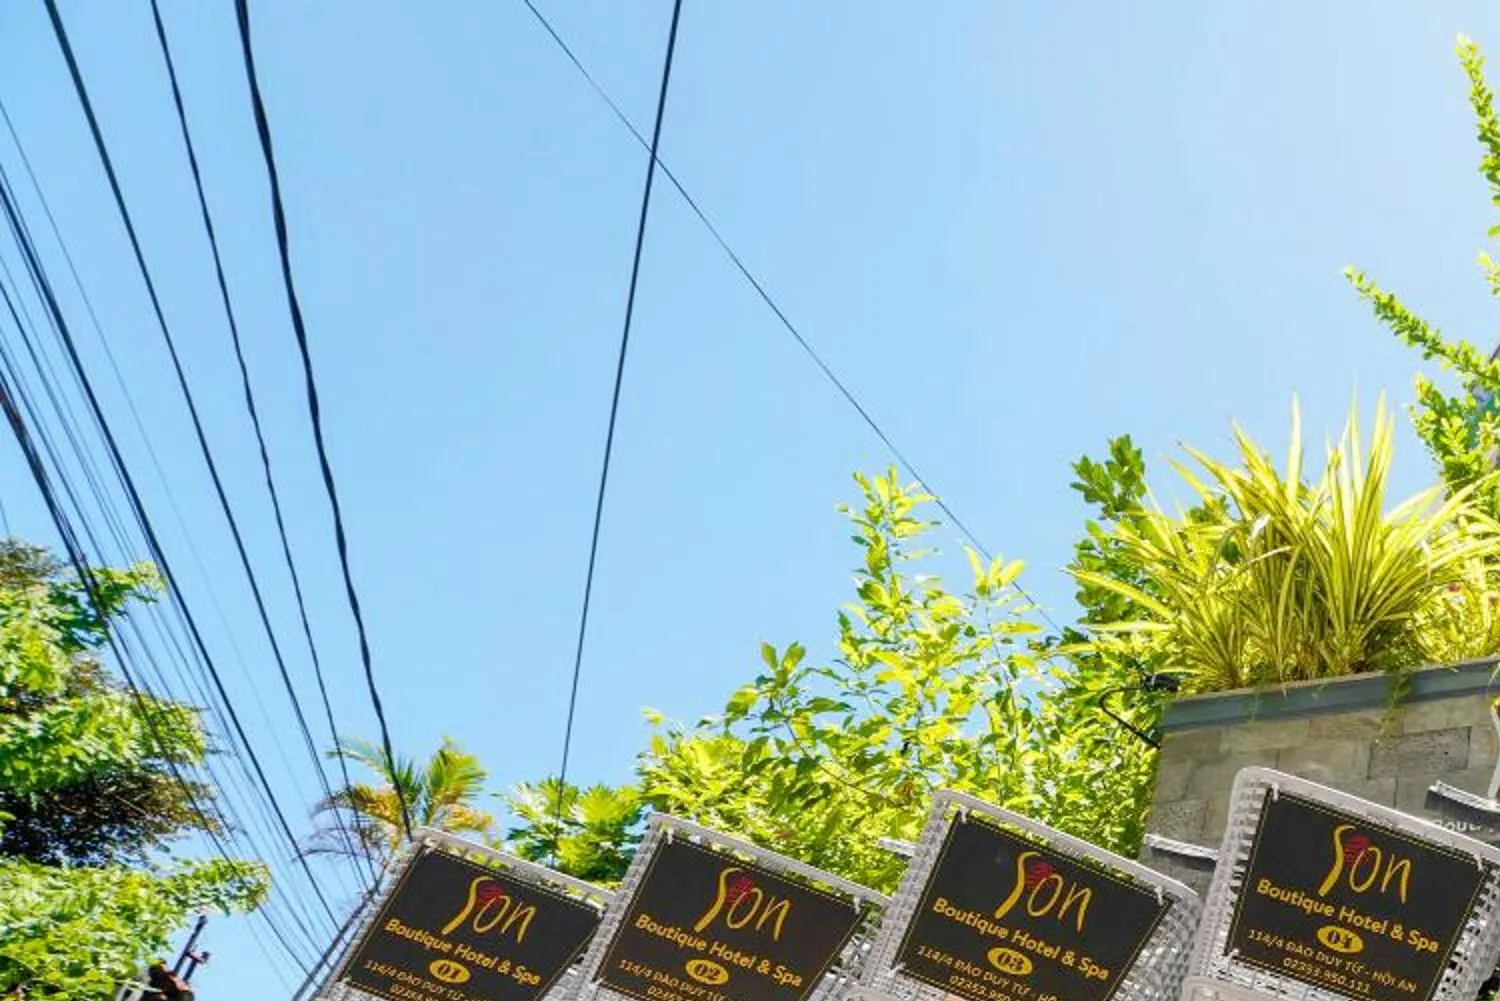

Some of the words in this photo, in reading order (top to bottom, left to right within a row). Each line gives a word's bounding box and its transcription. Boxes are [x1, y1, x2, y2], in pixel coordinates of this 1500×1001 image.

[995, 851, 1092, 932] Son
[1318, 825, 1411, 904] Son
[442, 876, 537, 944] Son
[694, 867, 791, 941] Son
[933, 897, 1009, 940] Boutique
[1012, 928, 1060, 960] Hotel
[1061, 948, 1075, 966] &
[1078, 957, 1110, 981] Spa
[1256, 879, 1335, 918] Boutique
[1339, 905, 1386, 935] Hotel
[1390, 924, 1404, 941] &
[1408, 930, 1440, 953] Spa
[385, 918, 452, 954] Boutique
[454, 943, 499, 969] Hotel
[498, 960, 510, 975] &
[512, 966, 542, 986] Spa
[635, 914, 707, 951] Boutique
[708, 940, 756, 969] Hotel
[756, 959, 770, 976] &
[772, 964, 803, 986] Spa
[1315, 952, 1344, 967] DUY
